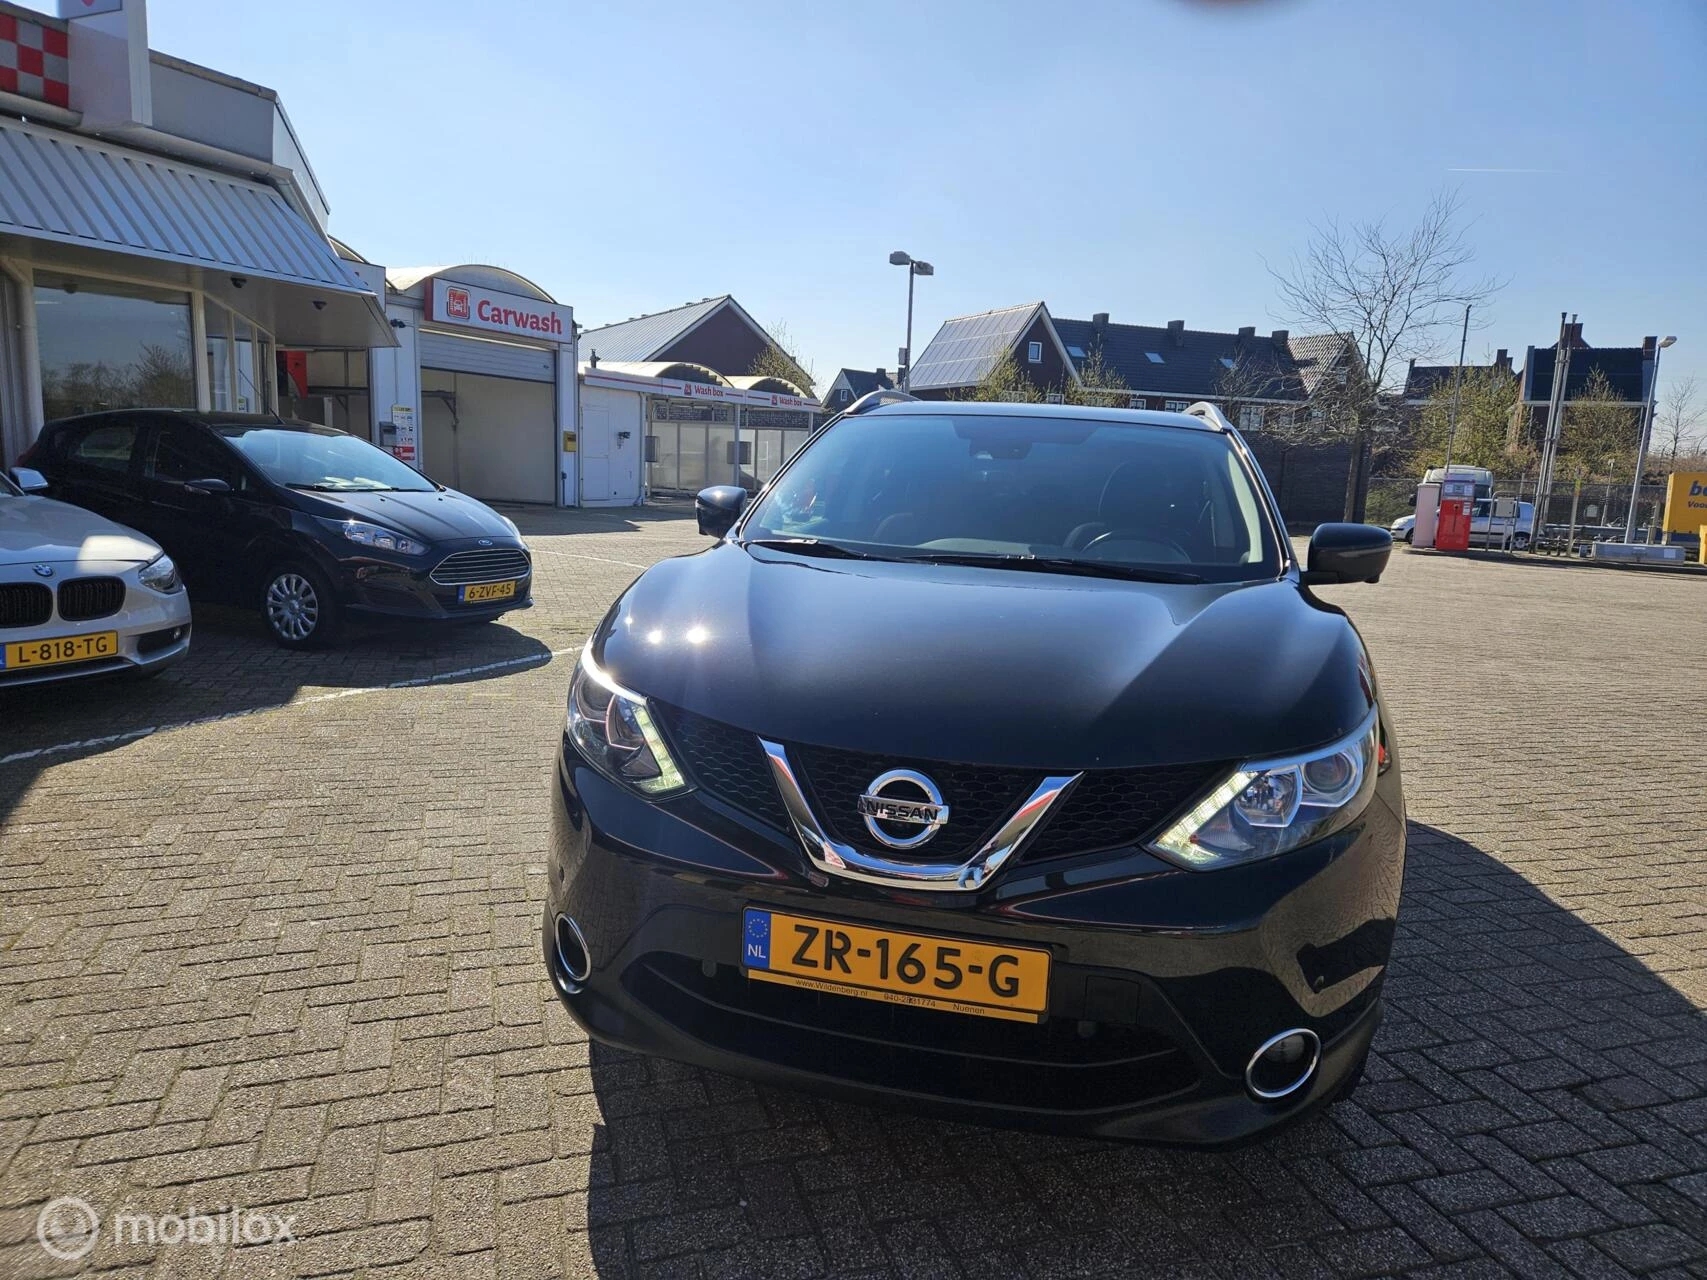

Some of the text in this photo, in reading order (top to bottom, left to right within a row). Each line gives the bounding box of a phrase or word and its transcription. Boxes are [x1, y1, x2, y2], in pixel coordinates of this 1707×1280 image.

[477, 300, 562, 334] Carwash
[694, 384, 724, 398] Wash box
[779, 396, 803, 407] Wash box
[468, 583, 512, 599] 6-ZVF-45
[18, 636, 108, 664] L-818-TG
[866, 801, 939, 821] NISSAN
[747, 943, 767, 960] NL
[791, 924, 1021, 998] ZR-165-G
[952, 1003, 985, 1015] Nuenen
